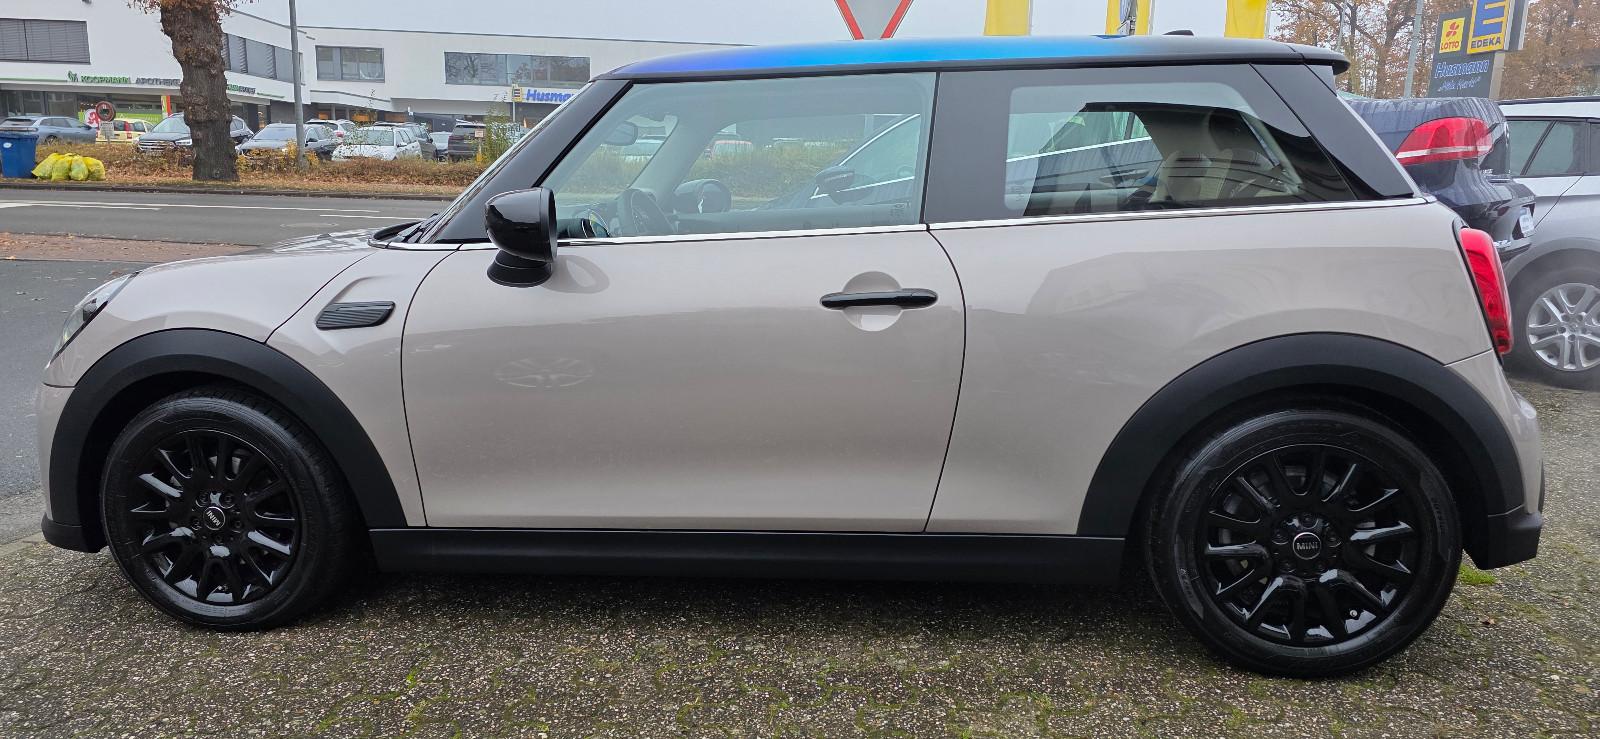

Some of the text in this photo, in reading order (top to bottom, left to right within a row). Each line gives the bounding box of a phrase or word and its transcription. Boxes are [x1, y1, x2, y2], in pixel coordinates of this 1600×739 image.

[1440, 41, 1460, 51] LOTTO
[1471, 36, 1502, 49] EDEKA
[1434, 60, 1490, 79] Husmann
[526, 88, 576, 102] Husma
[206, 510, 221, 526] MINI
[1296, 541, 1319, 551] MINI
